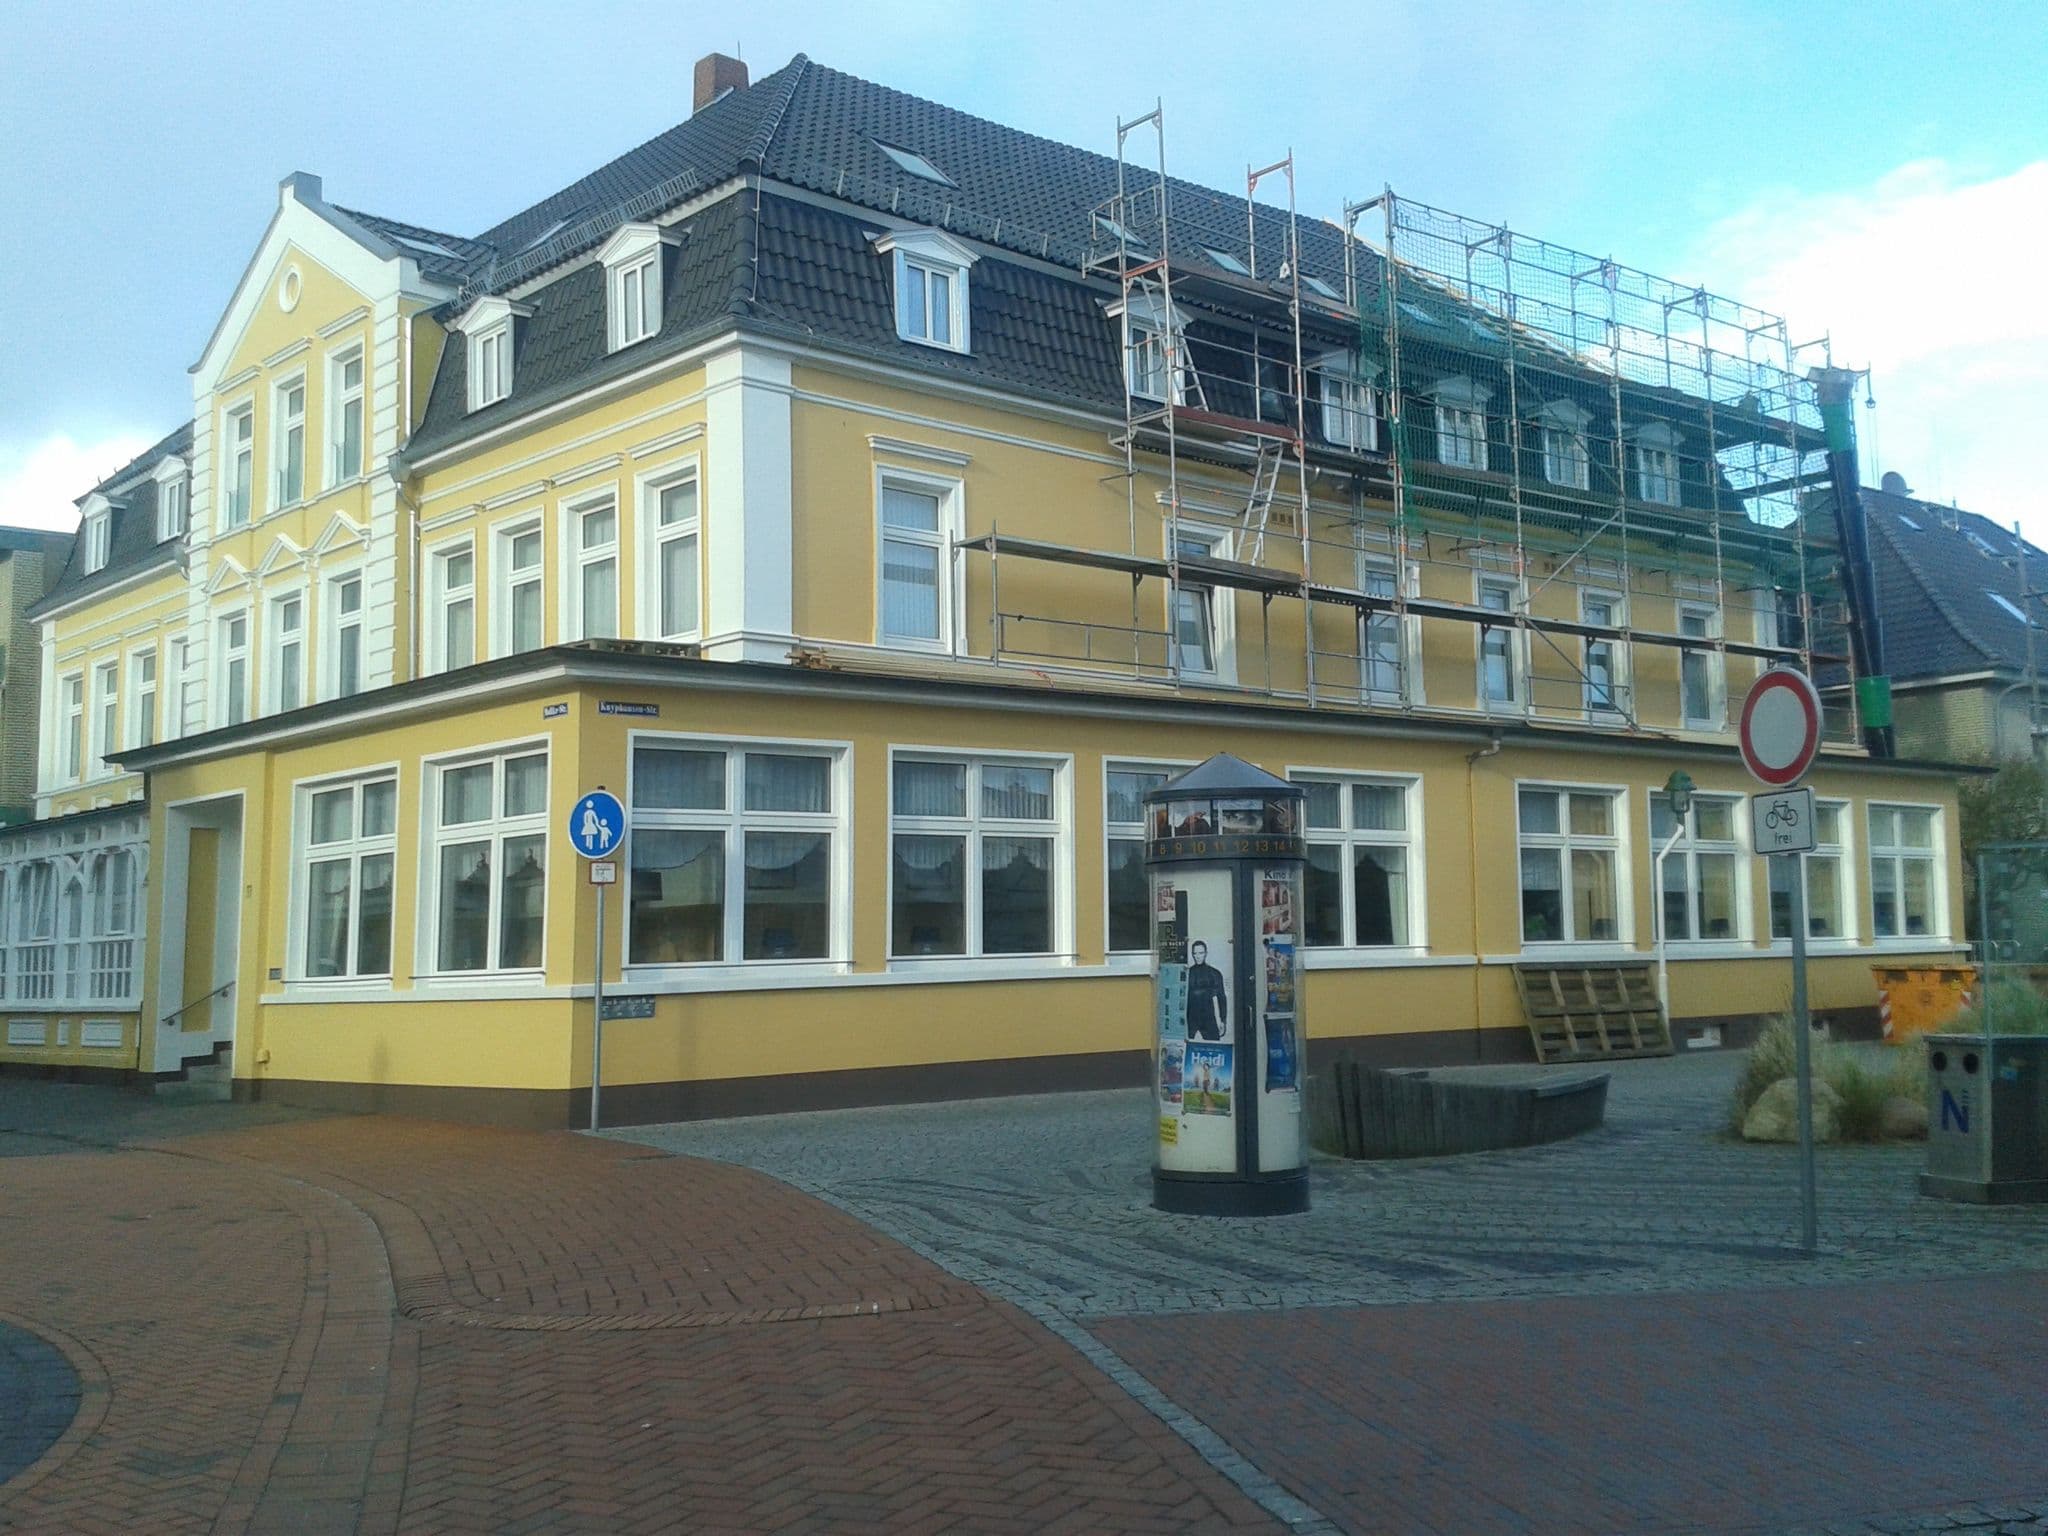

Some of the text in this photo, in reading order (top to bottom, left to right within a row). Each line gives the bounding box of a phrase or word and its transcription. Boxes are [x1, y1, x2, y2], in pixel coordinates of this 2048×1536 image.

[1774, 831, 1793, 844] frei
[1175, 843, 1184, 854] 9
[1192, 841, 1206, 853] 10
[1234, 841, 1249, 853] 12
[1255, 841, 1268, 853] 13
[1275, 841, 1286, 851] 14
[1264, 869, 1286, 879] Kino
[1191, 1051, 1225, 1066] Heidi
